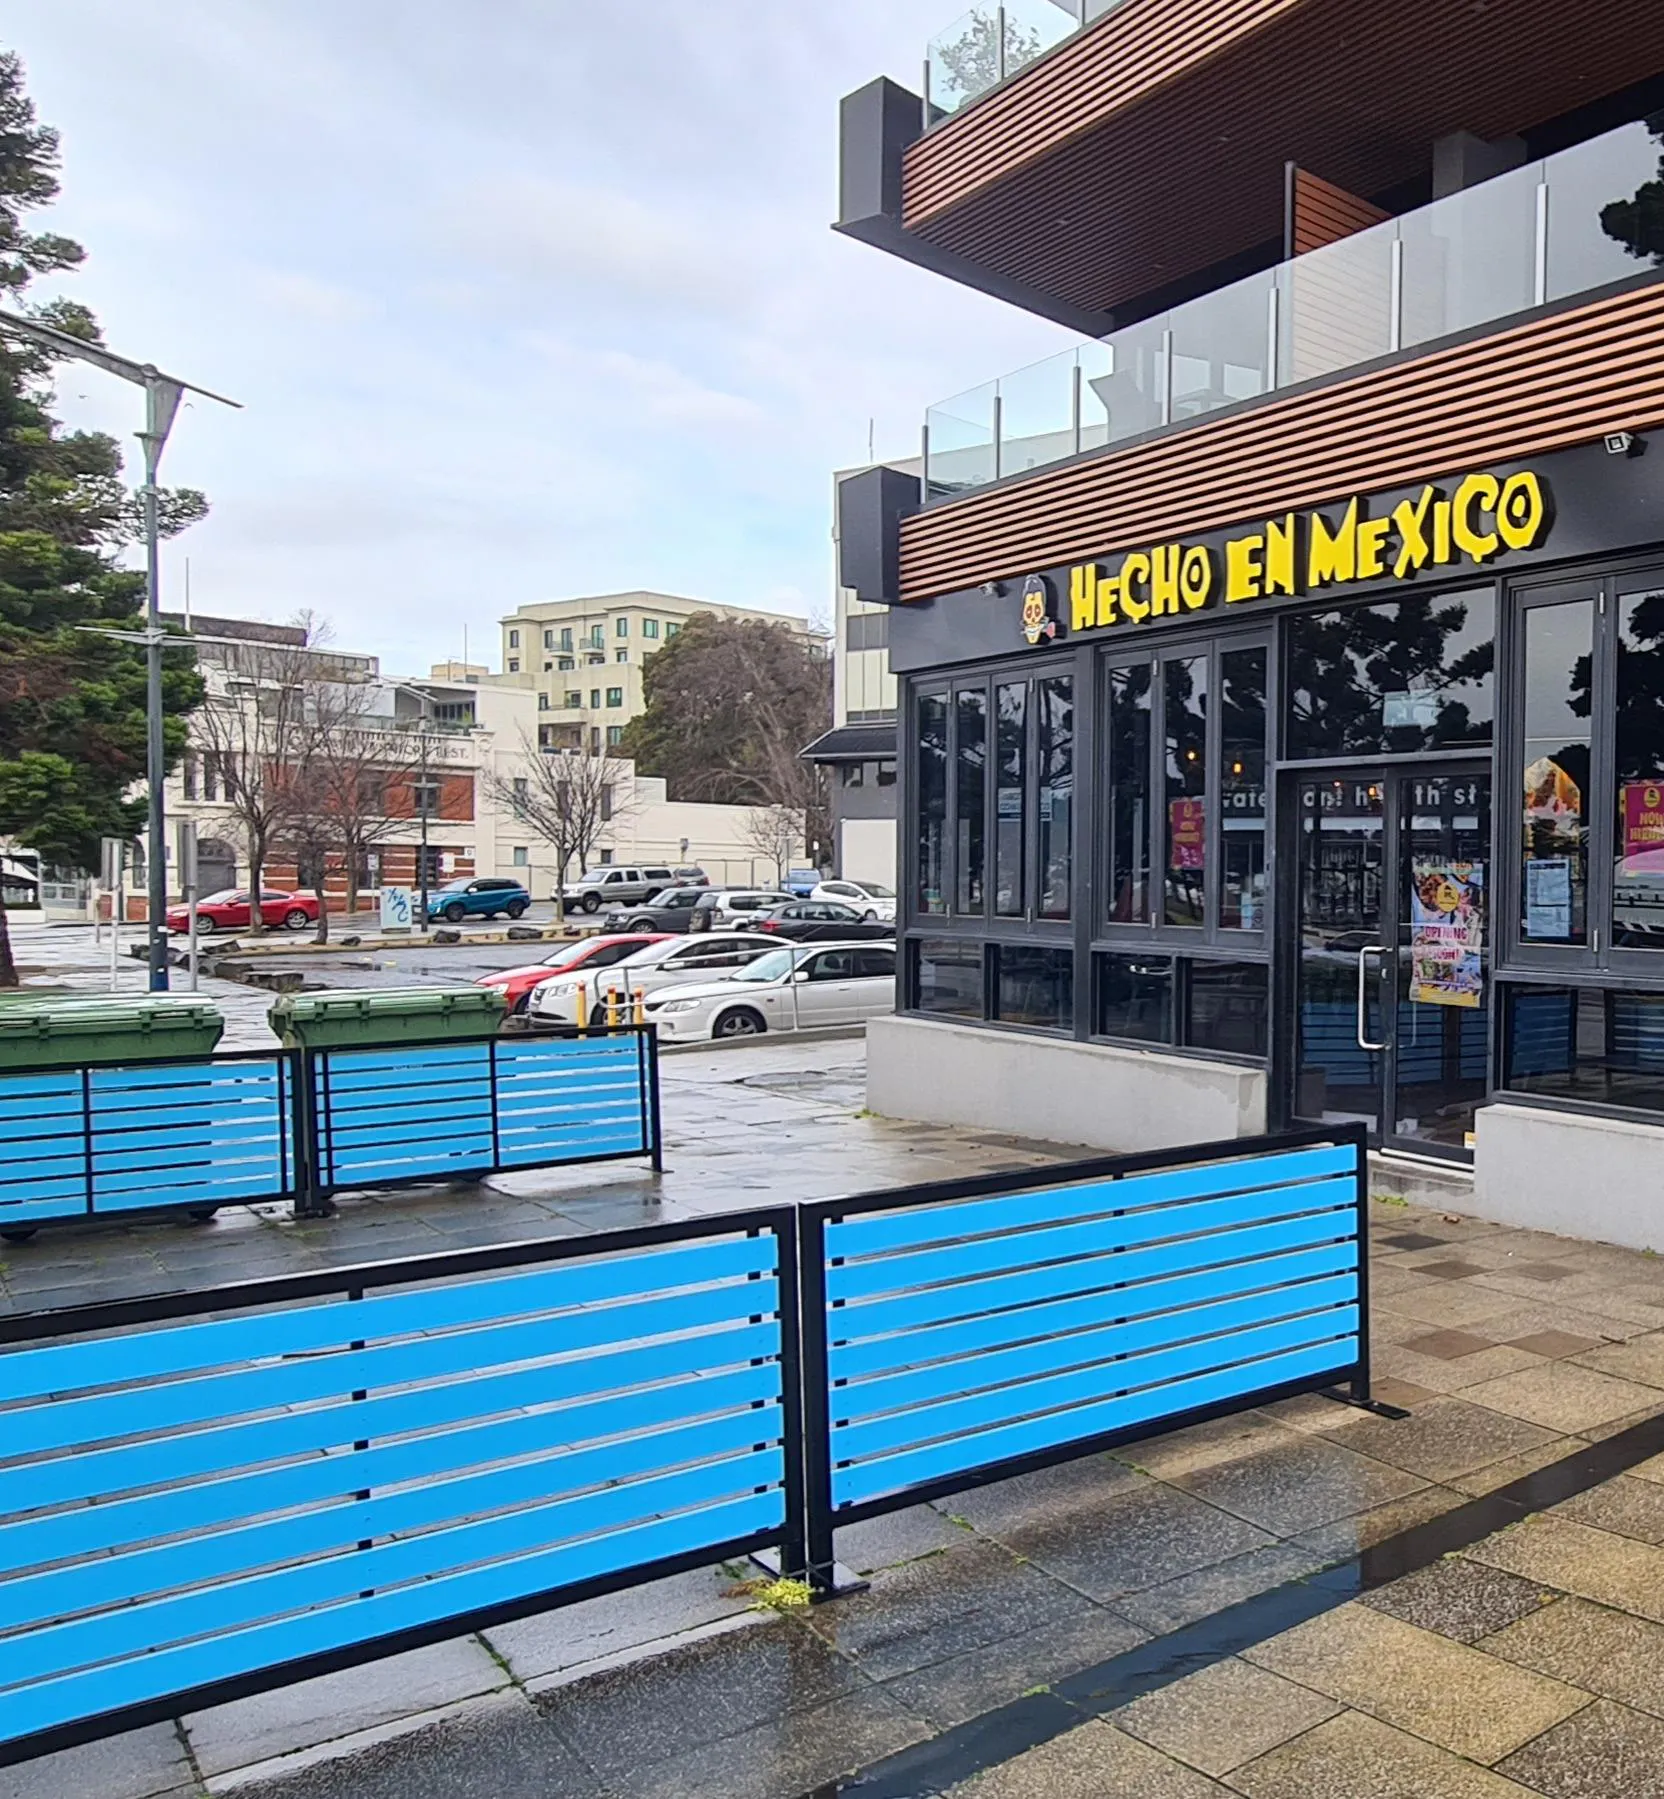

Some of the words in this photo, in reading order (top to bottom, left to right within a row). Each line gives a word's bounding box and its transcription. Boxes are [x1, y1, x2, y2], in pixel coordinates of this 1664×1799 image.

[1070, 544, 1212, 631] HECHO
[1225, 511, 1296, 604] EN
[1306, 470, 1544, 588] MEXICO
